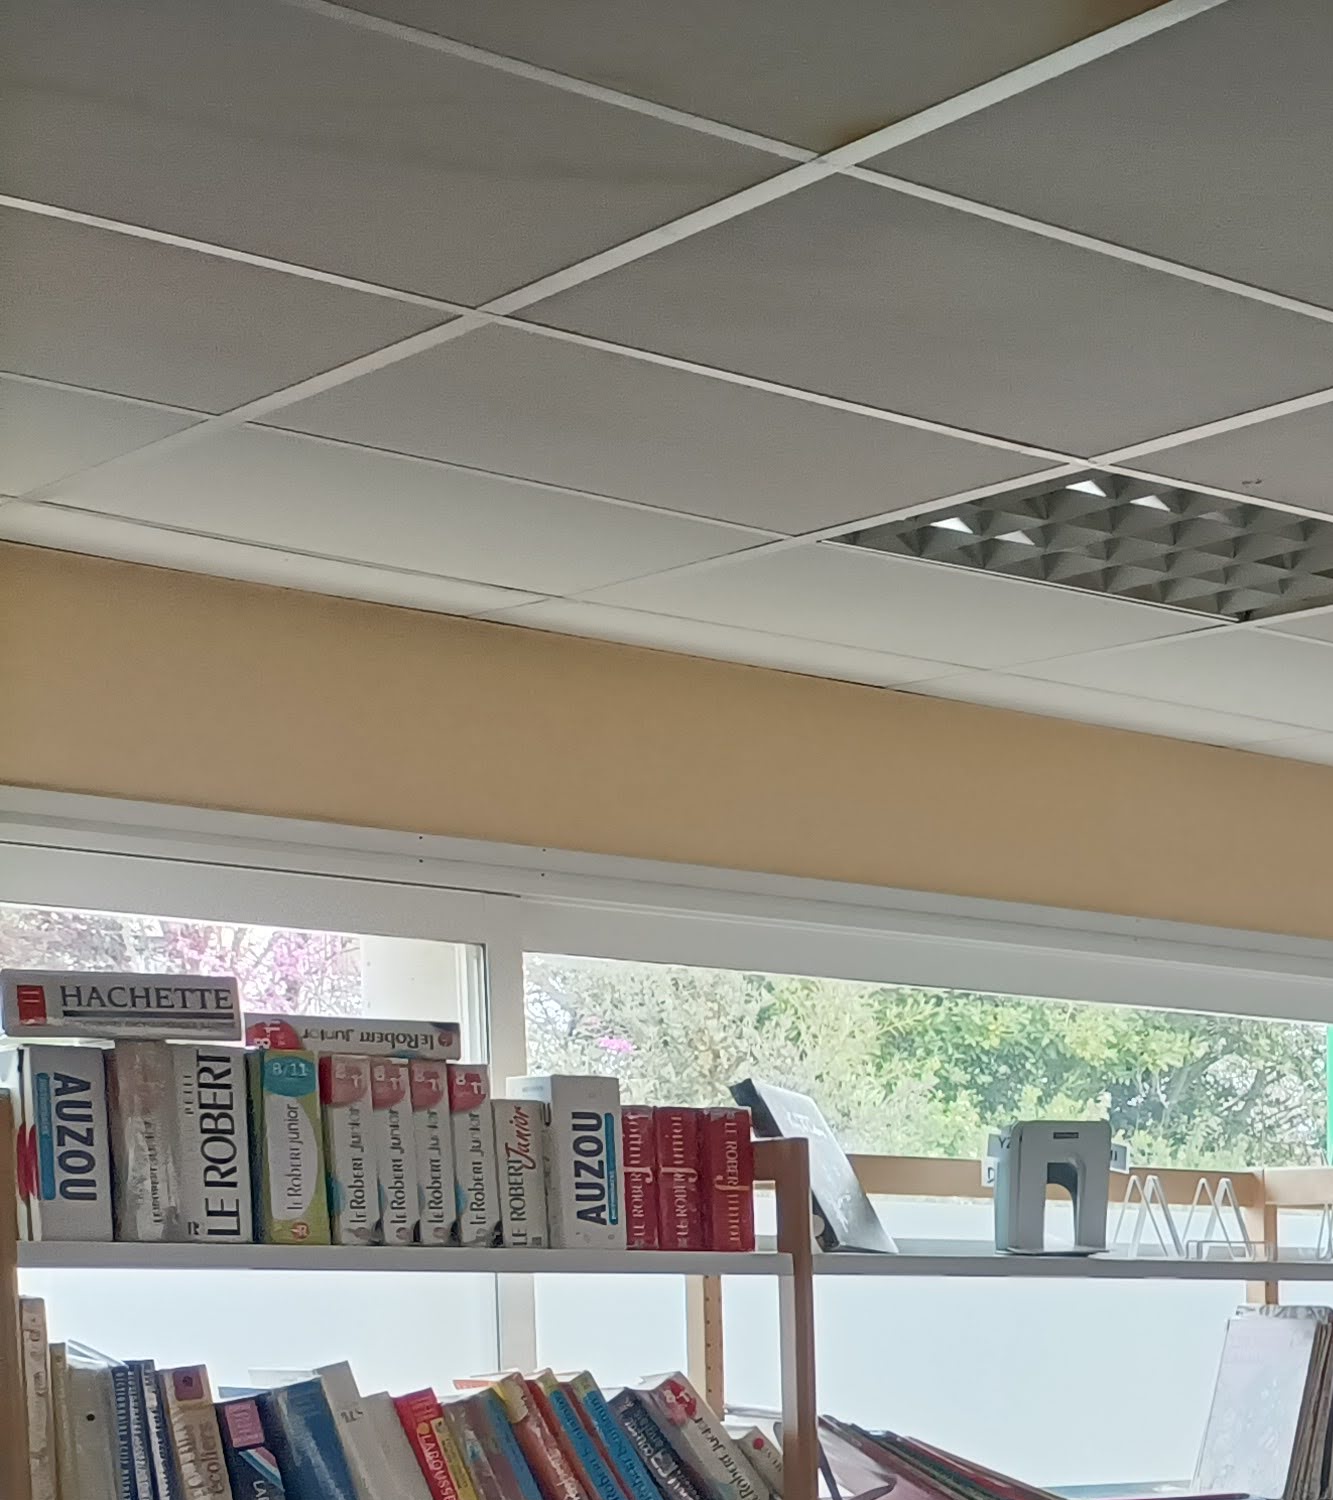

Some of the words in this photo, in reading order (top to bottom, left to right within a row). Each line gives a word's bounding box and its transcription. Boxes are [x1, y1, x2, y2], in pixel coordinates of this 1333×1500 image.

[60, 985, 234, 1010] HACHETTE
[54, 1072, 97, 1200] AUZOU
[196, 1050, 238, 1188] ROBERT
[505, 1105, 536, 1170] Junior
[508, 1157, 527, 1222] ROBERT
[571, 1111, 607, 1226] AUZOU
[204, 1197, 240, 1236] LE
